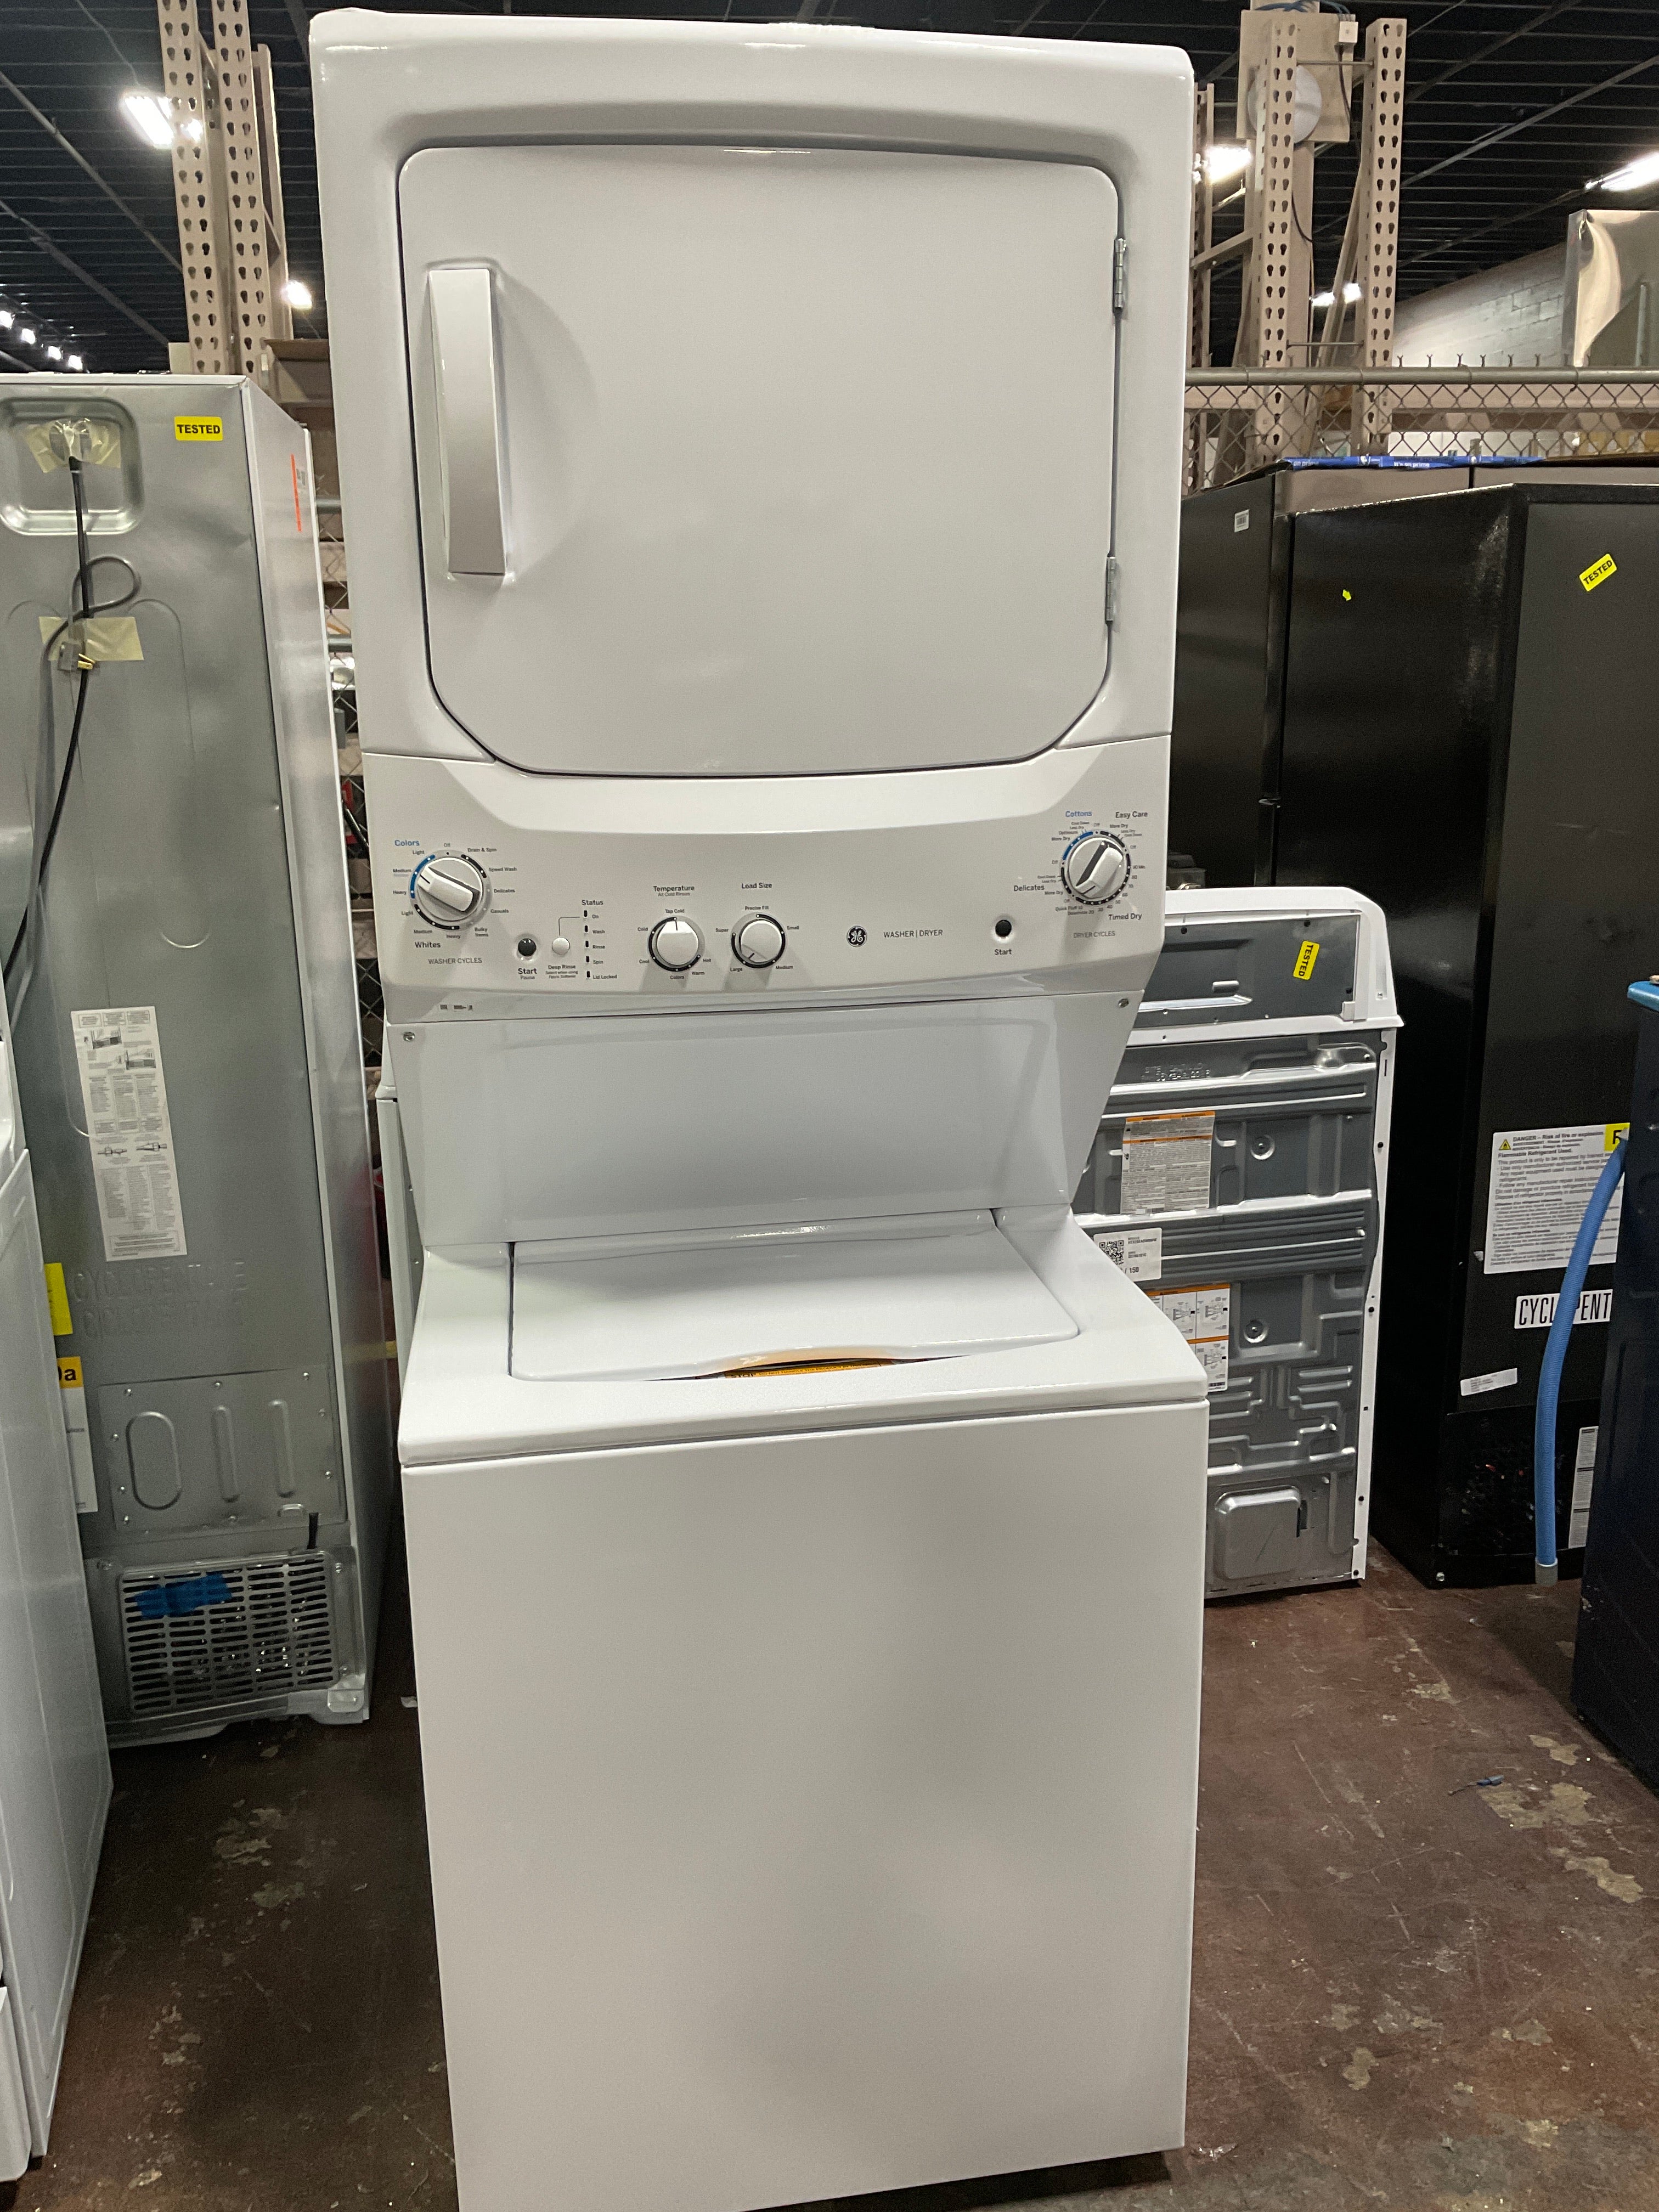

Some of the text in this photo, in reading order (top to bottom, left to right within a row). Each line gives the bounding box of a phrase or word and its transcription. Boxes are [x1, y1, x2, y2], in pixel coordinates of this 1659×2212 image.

[177, 424, 220, 434] TESTED
[1583, 560, 1612, 584] TESTED
[1299, 945, 1314, 977] TESTED
[1519, 1293, 1611, 1327] CYCLENT
